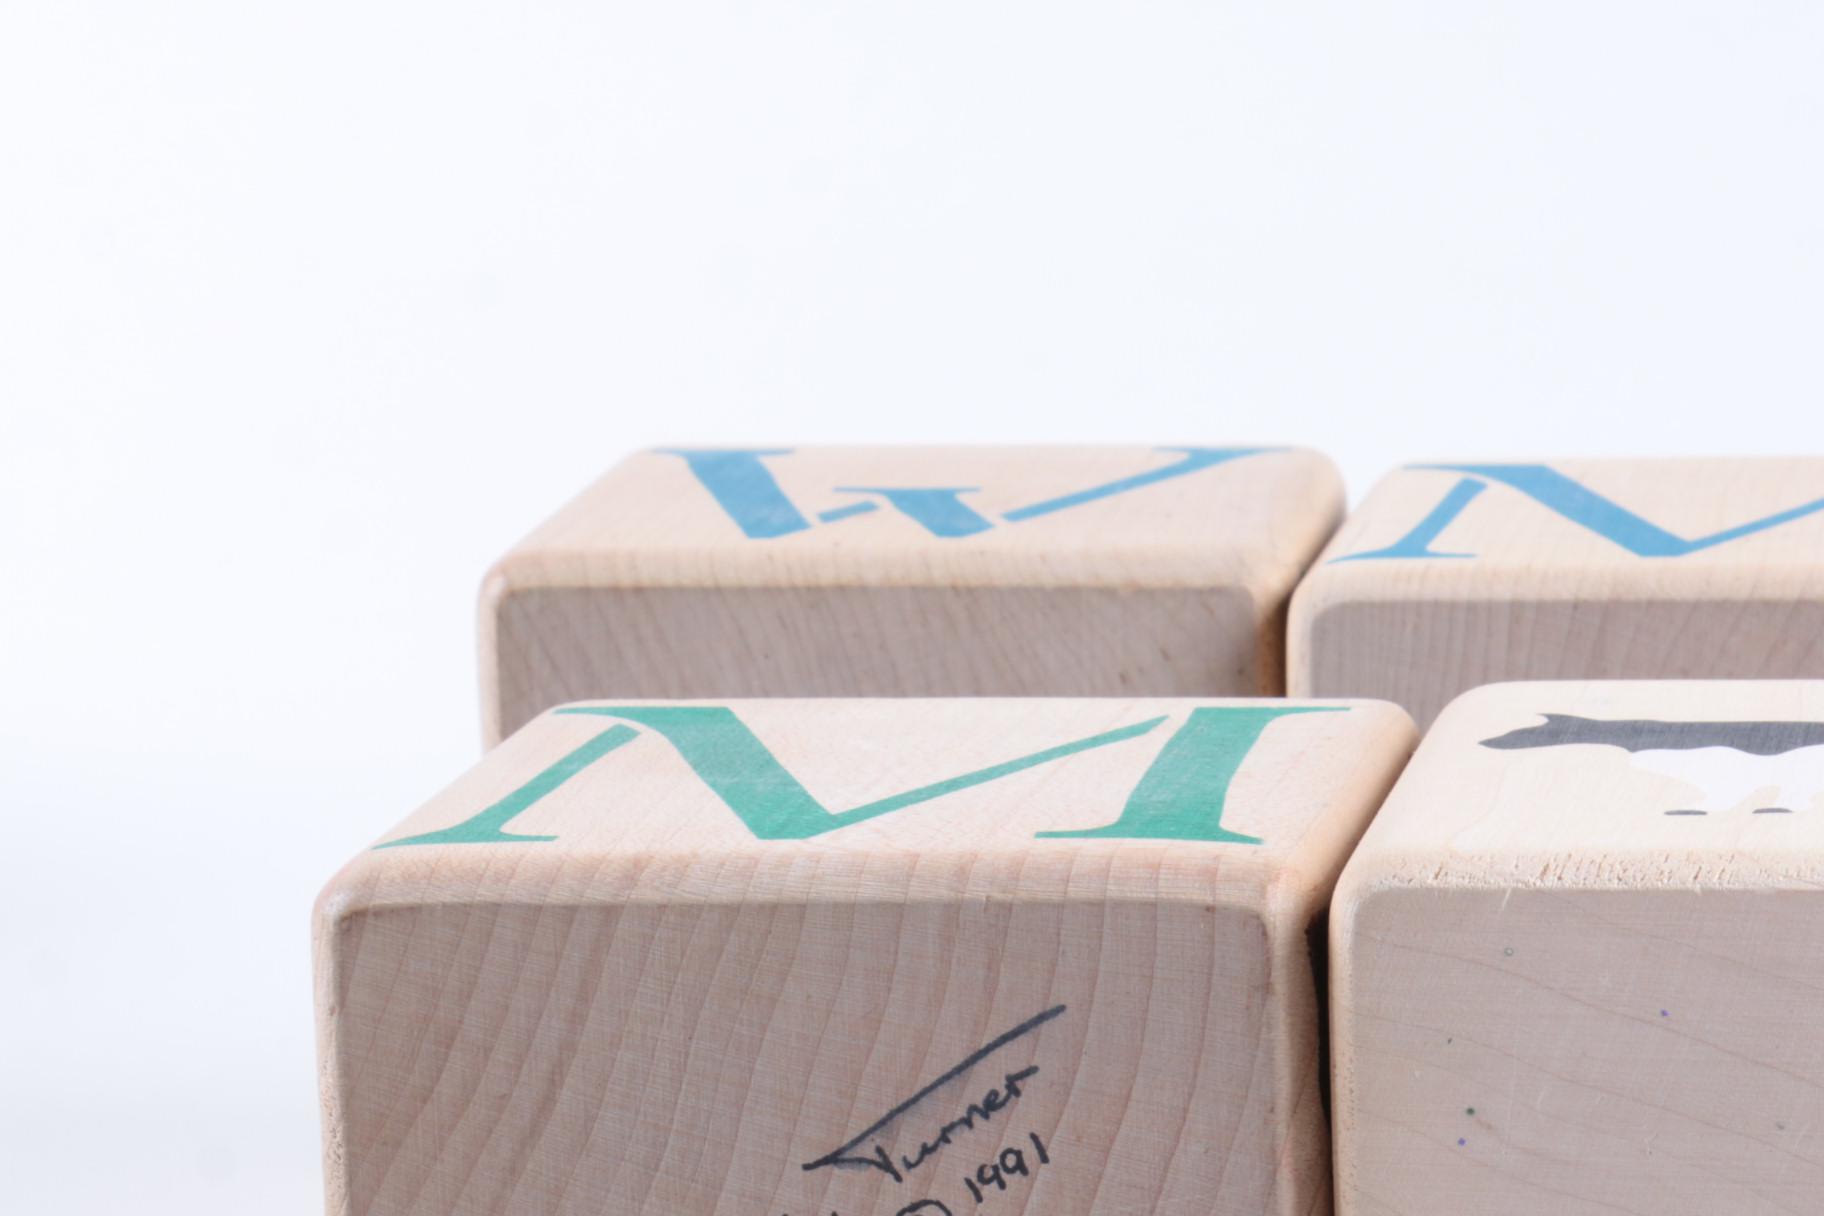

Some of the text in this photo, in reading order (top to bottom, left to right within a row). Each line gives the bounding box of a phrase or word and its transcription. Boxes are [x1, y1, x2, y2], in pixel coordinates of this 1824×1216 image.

[652, 447, 1293, 539] W
[370, 706, 1351, 850] M
[802, 1004, 1067, 1183] Turner
